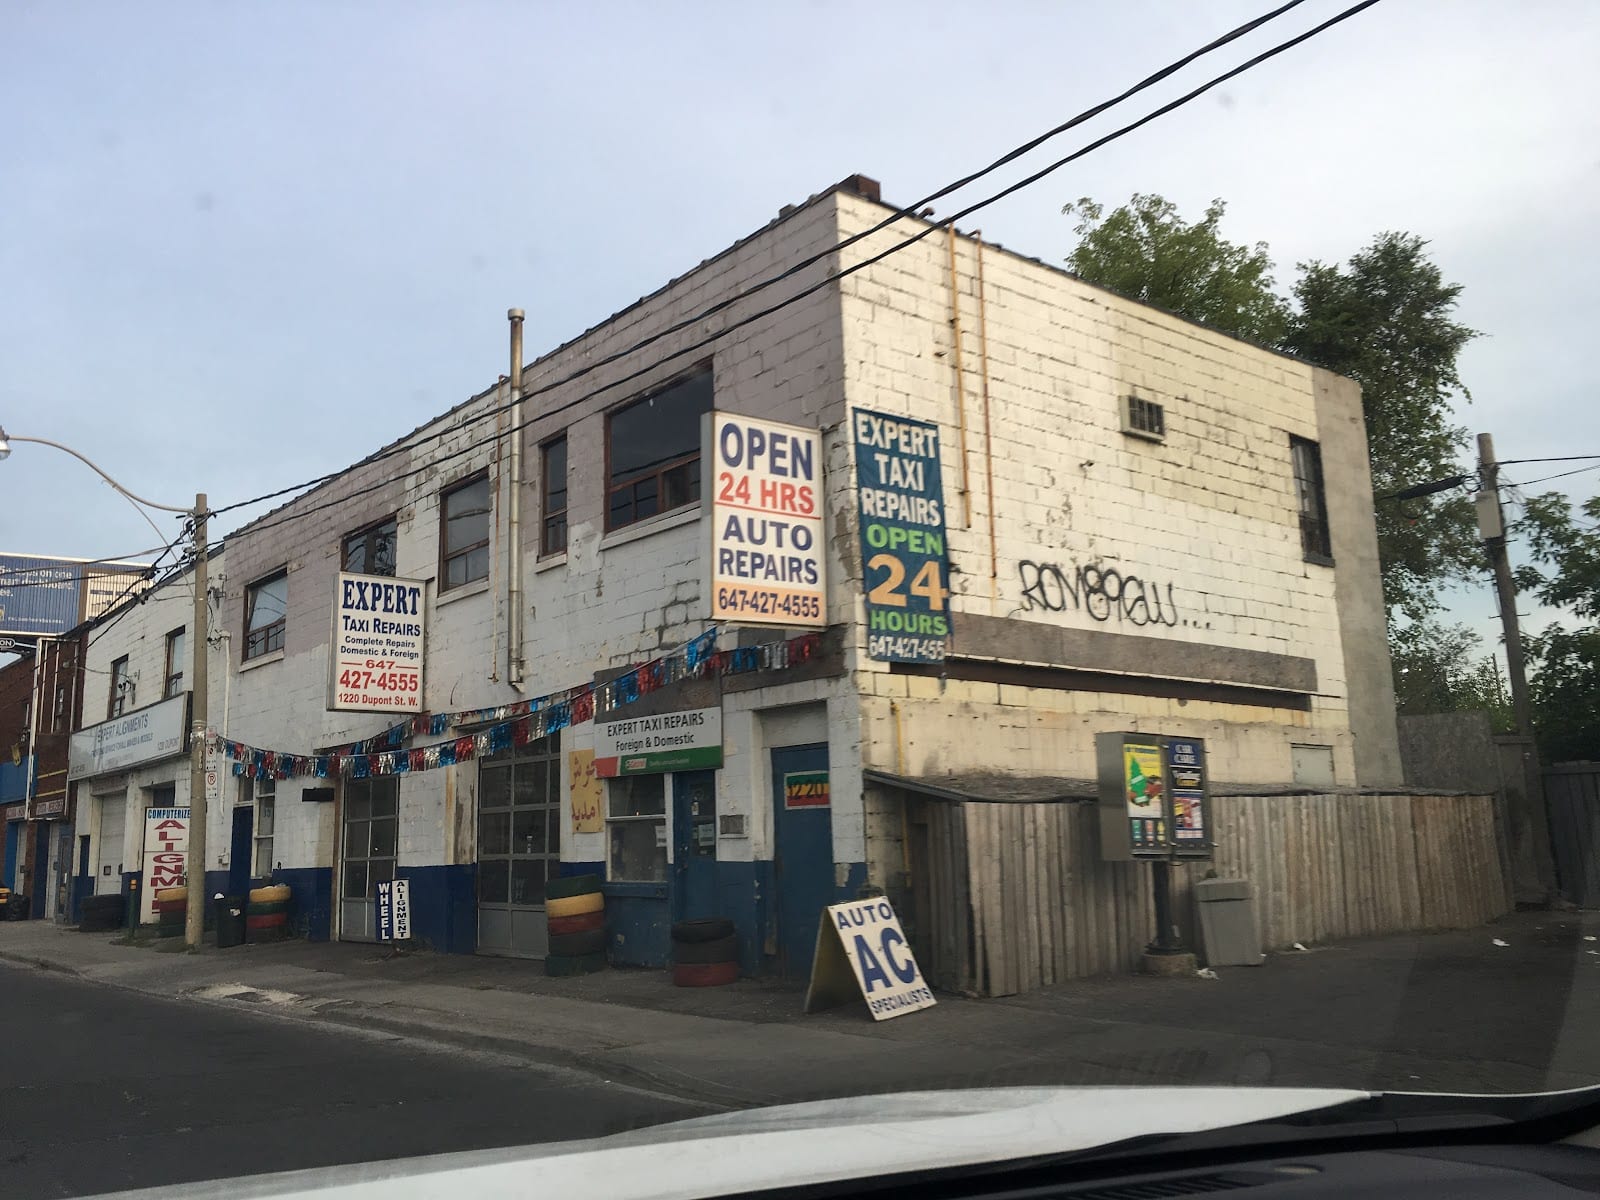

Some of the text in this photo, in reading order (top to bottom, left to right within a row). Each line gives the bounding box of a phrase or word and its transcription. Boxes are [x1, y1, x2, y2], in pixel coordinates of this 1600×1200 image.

[856, 412, 938, 458] EXPERT
[720, 423, 814, 481] OPEN
[874, 453, 925, 491] TAXI
[719, 472, 815, 514] 24 HRS
[861, 487, 941, 527] REPAIRS
[723, 515, 813, 551] AUTO
[866, 523, 944, 556] OPEN
[719, 548, 818, 585] REPAIRS
[867, 553, 948, 611] 24
[342, 580, 421, 615] EXPERT
[719, 588, 820, 619] 647-427-4555
[343, 615, 421, 637] TAXI REPAIRS
[871, 609, 948, 636] HOURS
[340, 645, 419, 661] Domestic & Foreign
[345, 635, 416, 648] Complete Repairs
[365, 659, 396, 670] 647
[340, 669, 418, 692] 427-4555
[338, 693, 418, 706] 1220 Dupont St. W.
[116, 713, 149, 737] ALIGNMENTS
[607, 712, 705, 737] EXPERT TAXI REPAIRS
[616, 731, 695, 752] Foreign & Domestic
[147, 808, 190, 819] COMPUTERIZE
[378, 882, 390, 940] WHEEL
[396, 881, 407, 938] ALIGNMENT
[836, 902, 893, 930] AUTO
[853, 926, 916, 993] AC
[871, 987, 931, 1014] SPECIALISTS
